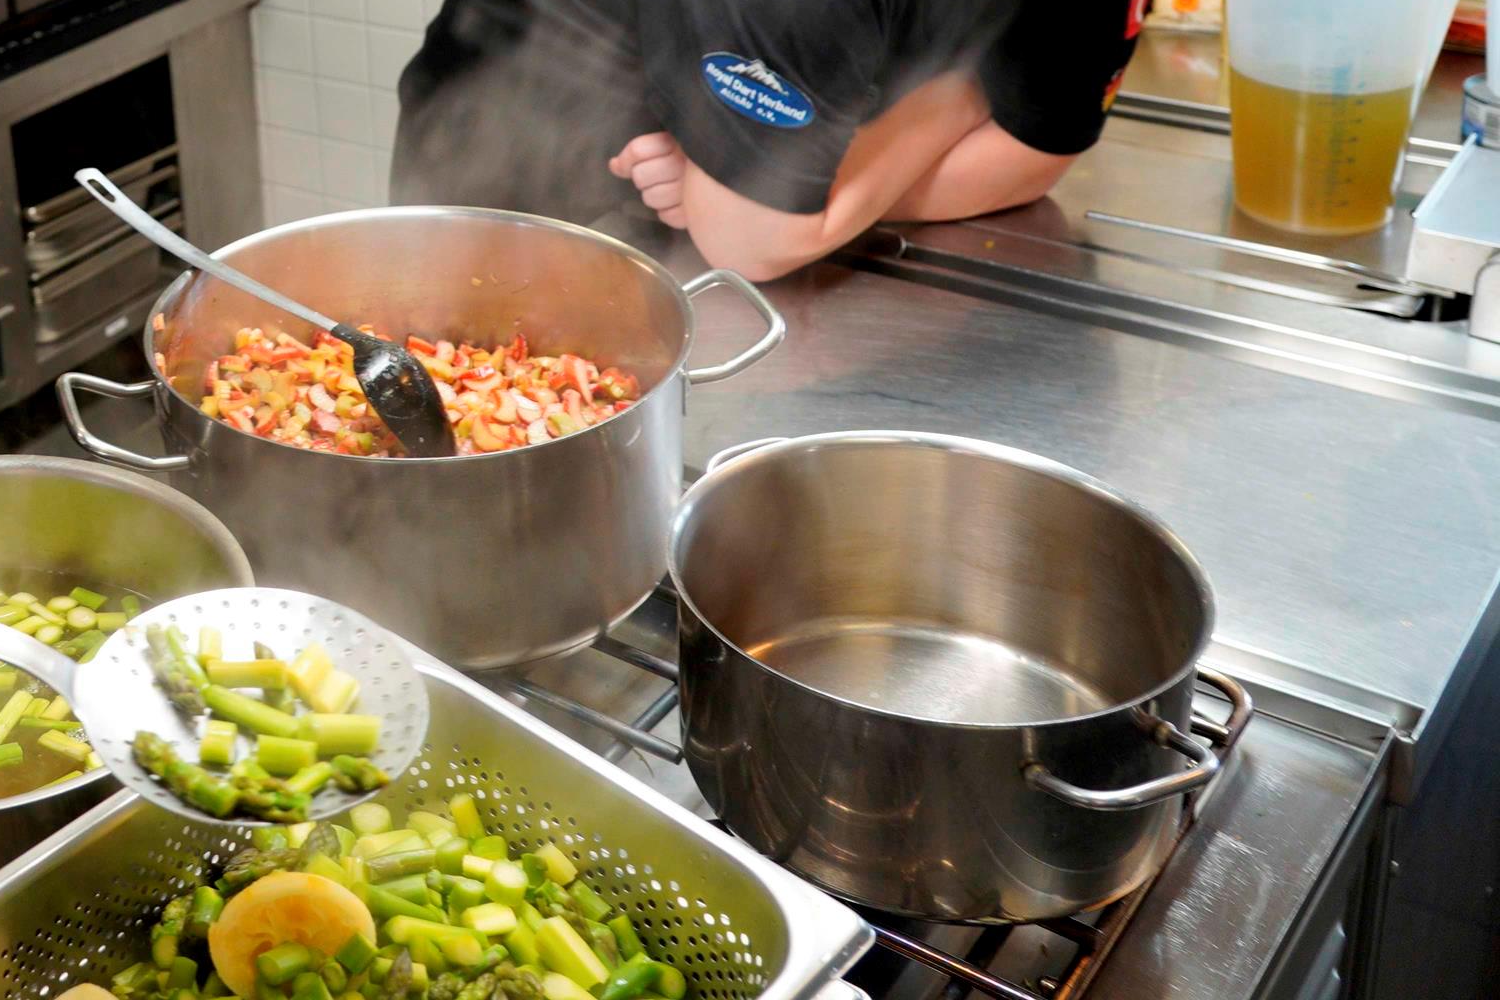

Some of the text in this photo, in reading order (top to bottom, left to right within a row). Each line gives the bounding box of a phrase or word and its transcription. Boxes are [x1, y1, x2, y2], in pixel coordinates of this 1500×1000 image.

[706, 62, 807, 121] Royal Dart Verband
